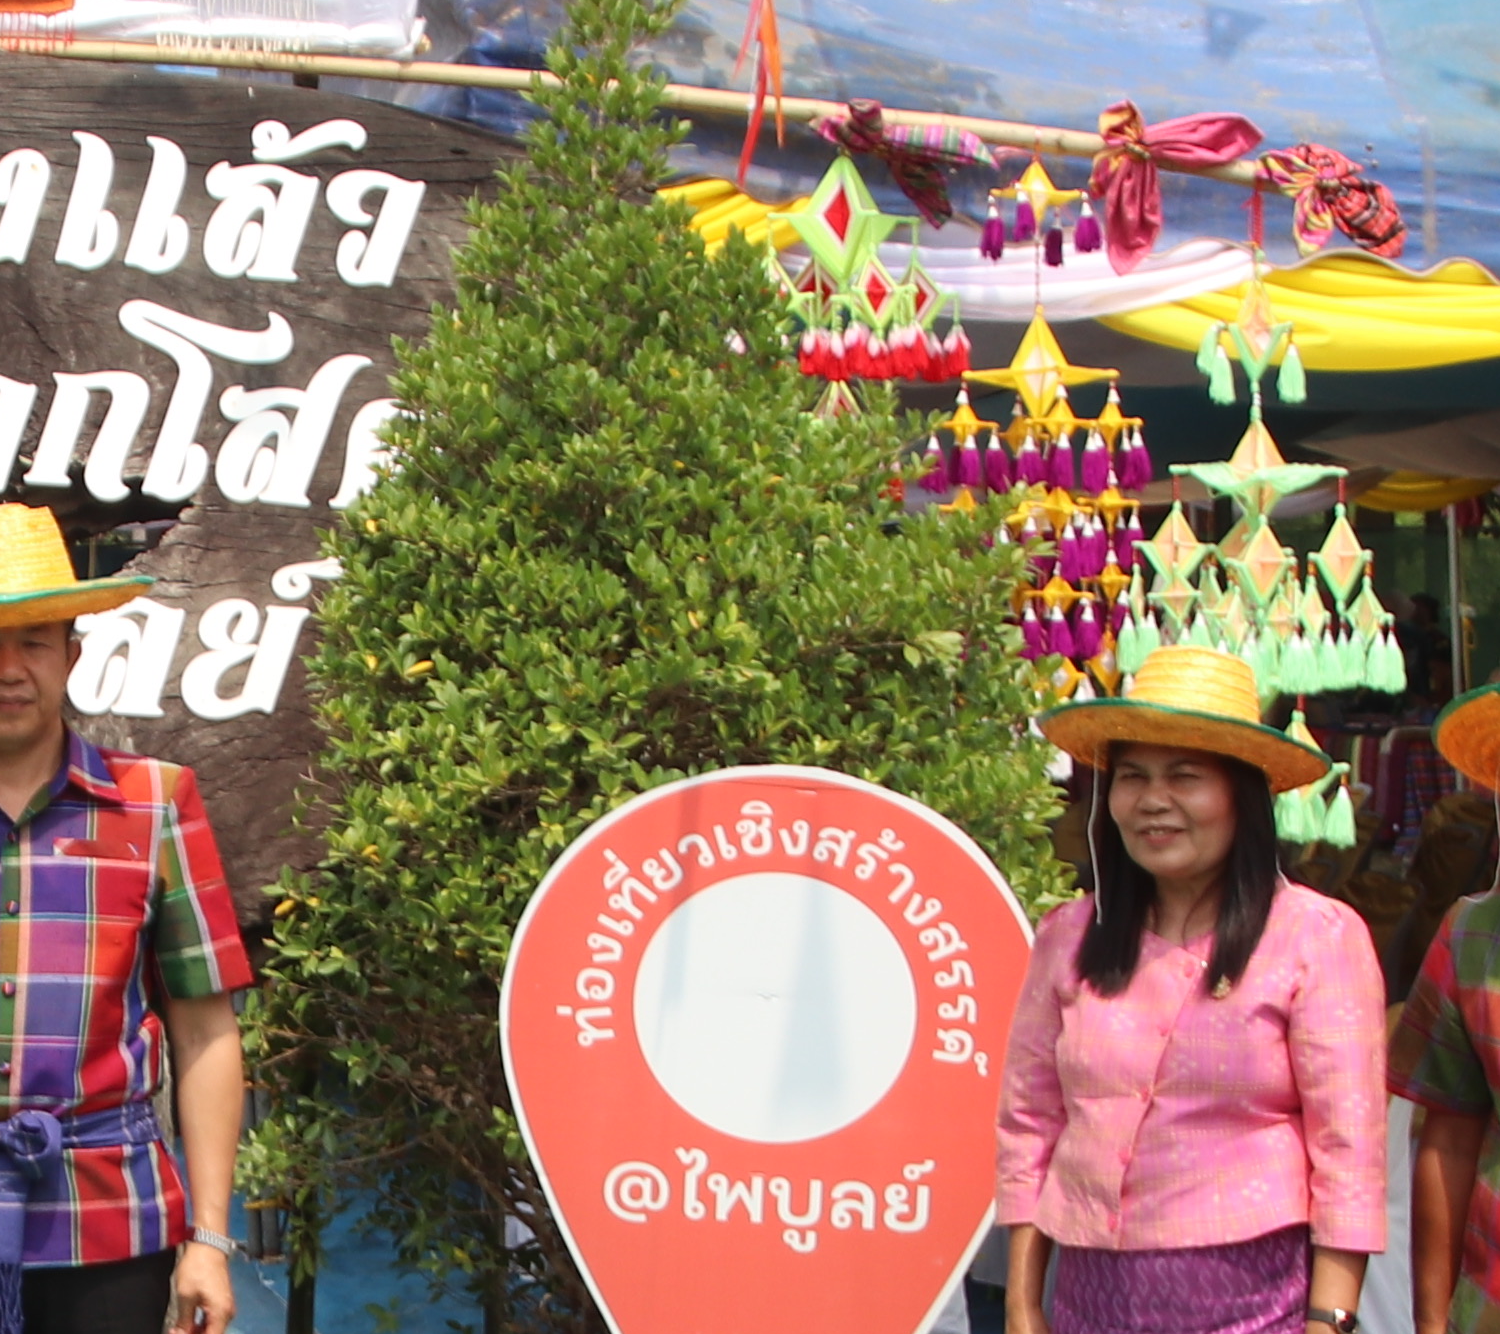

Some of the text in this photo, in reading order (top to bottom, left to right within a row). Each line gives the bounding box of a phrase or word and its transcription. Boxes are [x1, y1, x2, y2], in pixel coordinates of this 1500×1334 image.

[555, 799, 988, 1076] ท่องเที่ยวเชิงสร้างสรรค์
[602, 1146, 936, 1254] @ไพบูลย์
